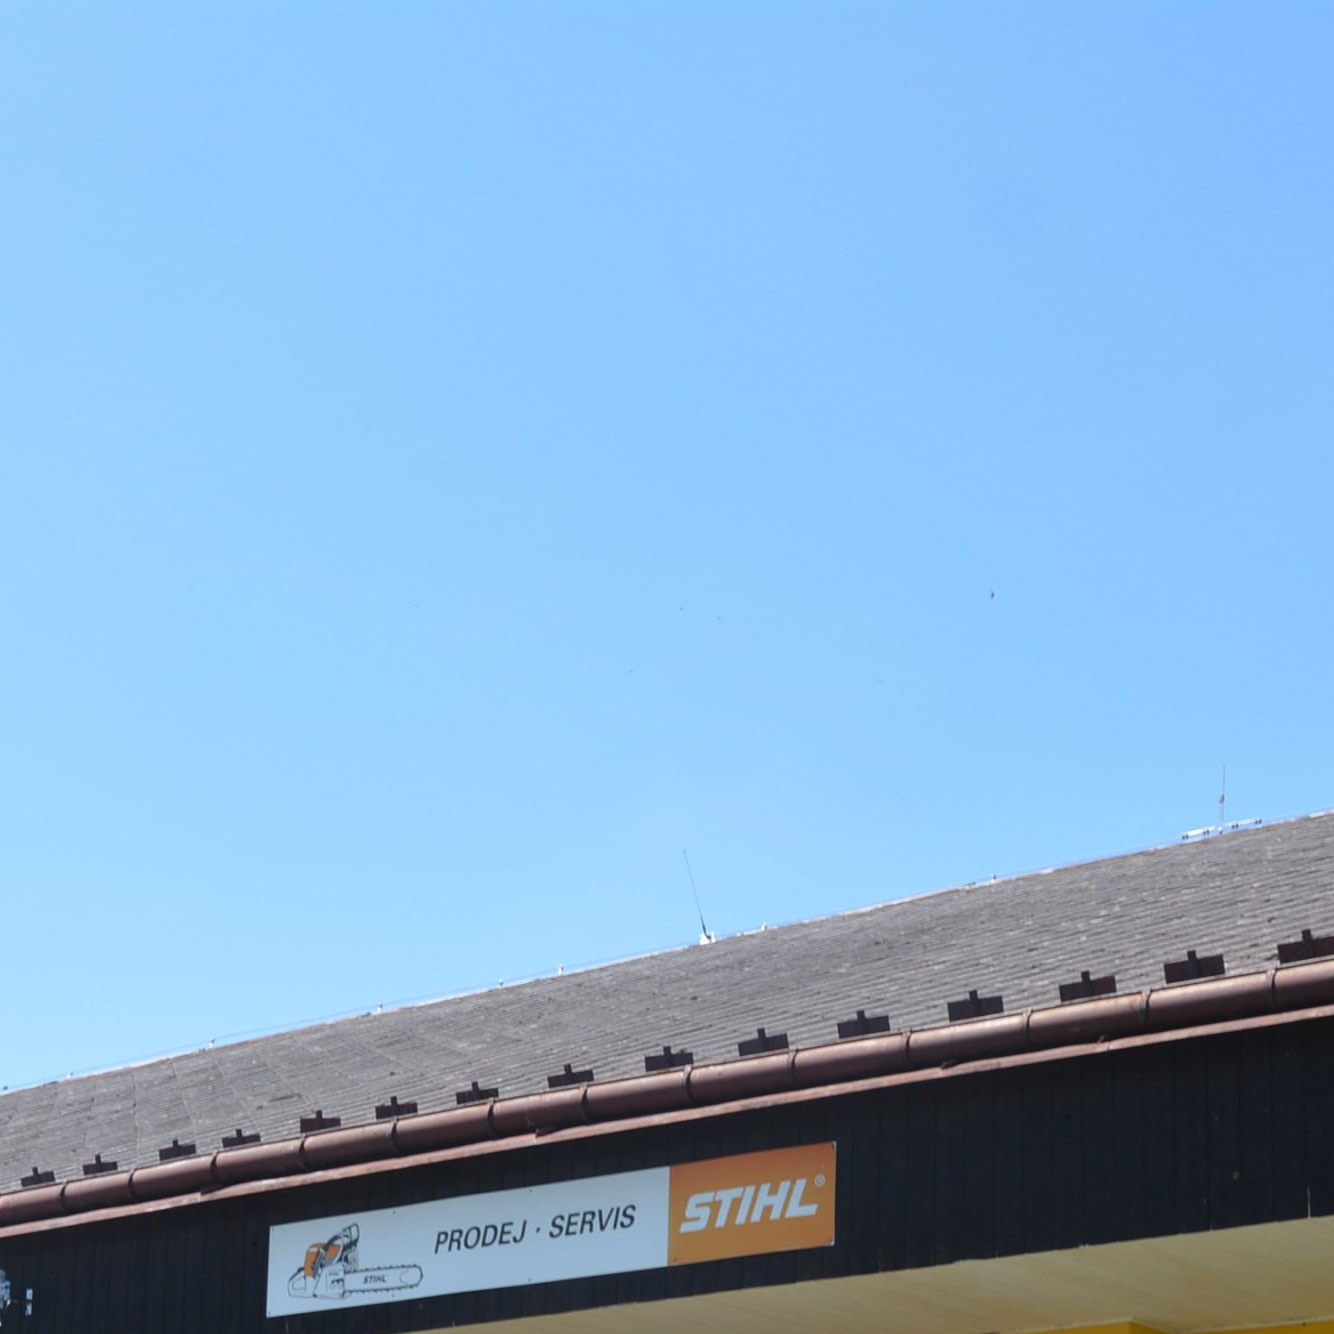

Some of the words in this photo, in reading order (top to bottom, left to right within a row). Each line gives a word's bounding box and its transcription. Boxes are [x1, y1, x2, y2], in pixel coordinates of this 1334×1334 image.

[434, 1219, 527, 1255] PRODEJ
[549, 1203, 636, 1240] SERVIS
[678, 1177, 819, 1235] STIHL
[362, 1274, 388, 1286] STIHL
